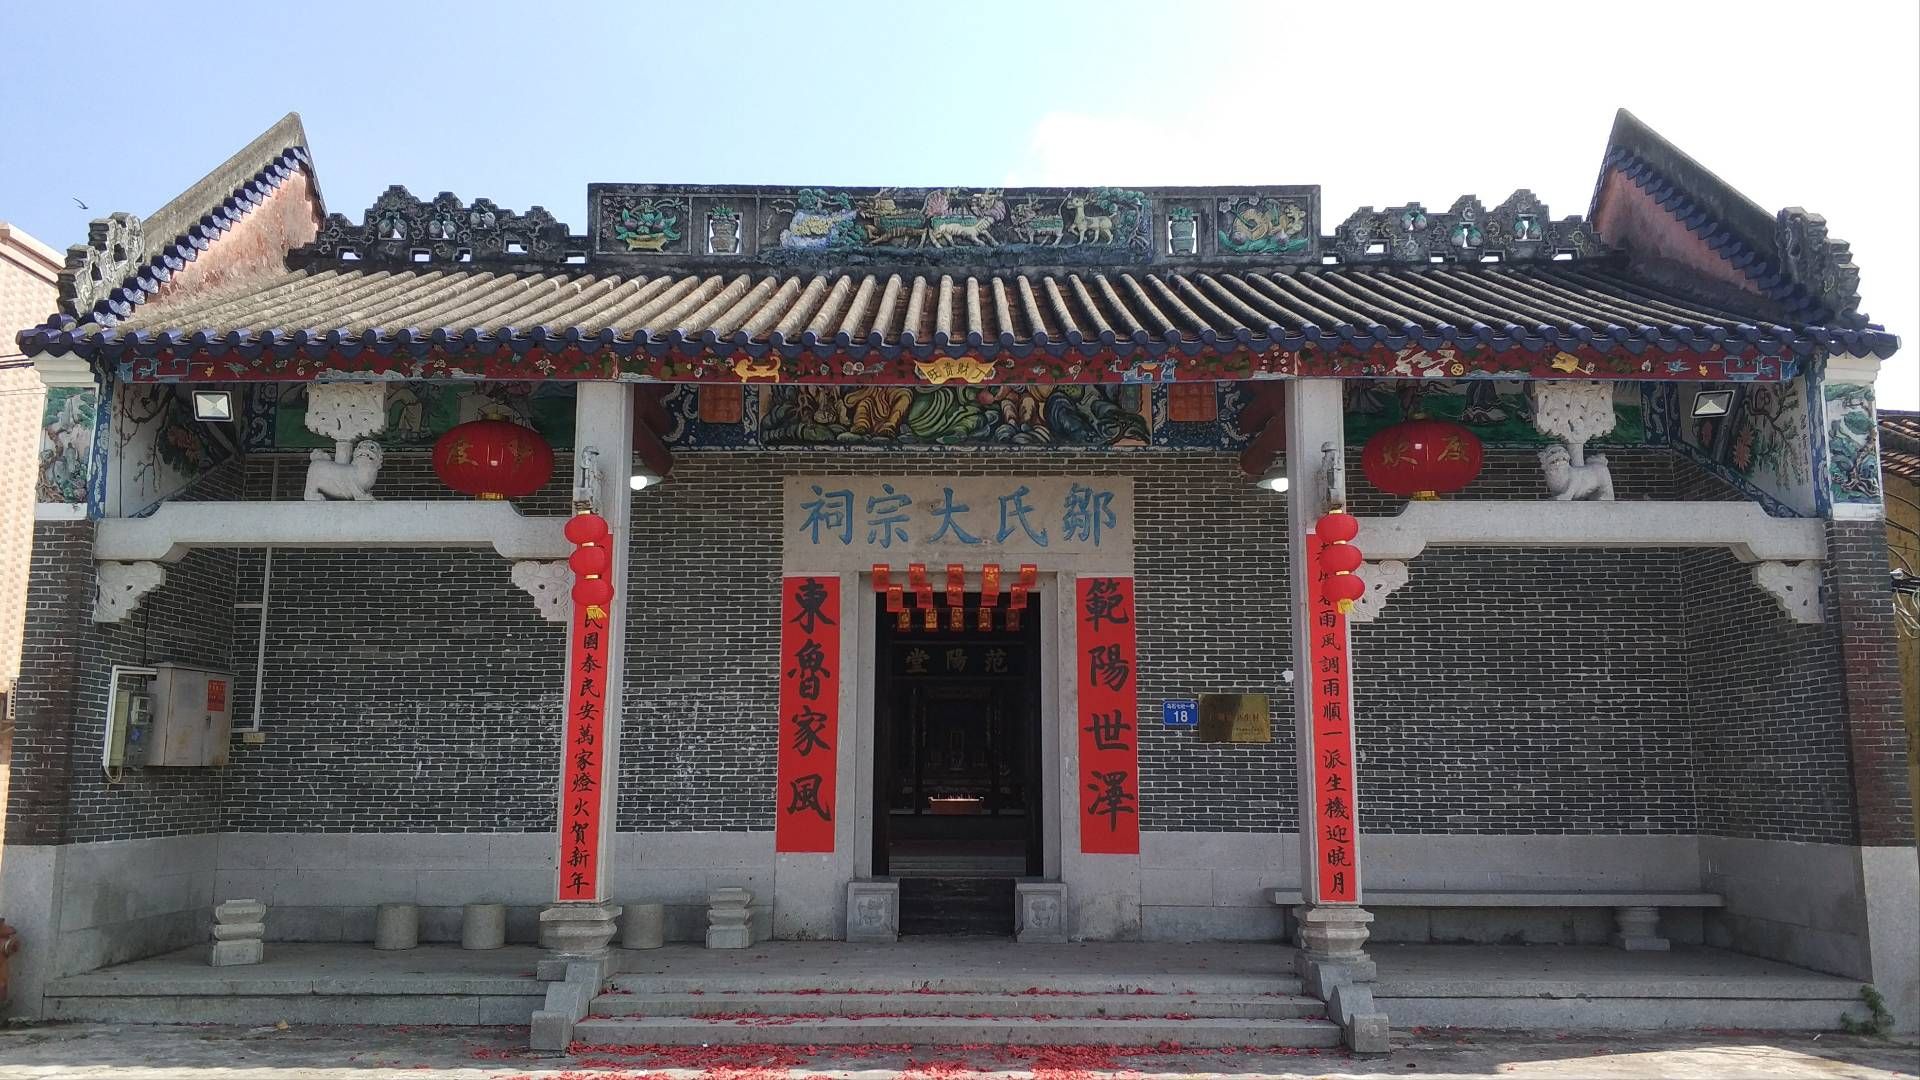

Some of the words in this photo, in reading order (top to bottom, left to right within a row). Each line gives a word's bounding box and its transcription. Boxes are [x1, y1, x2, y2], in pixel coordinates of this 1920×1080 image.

[799, 483, 1117, 548] 鄒氏大宗祠
[787, 577, 838, 822] 東魯家風
[1083, 577, 1135, 833] 範陽世澤
[1173, 710, 1188, 723] 18
